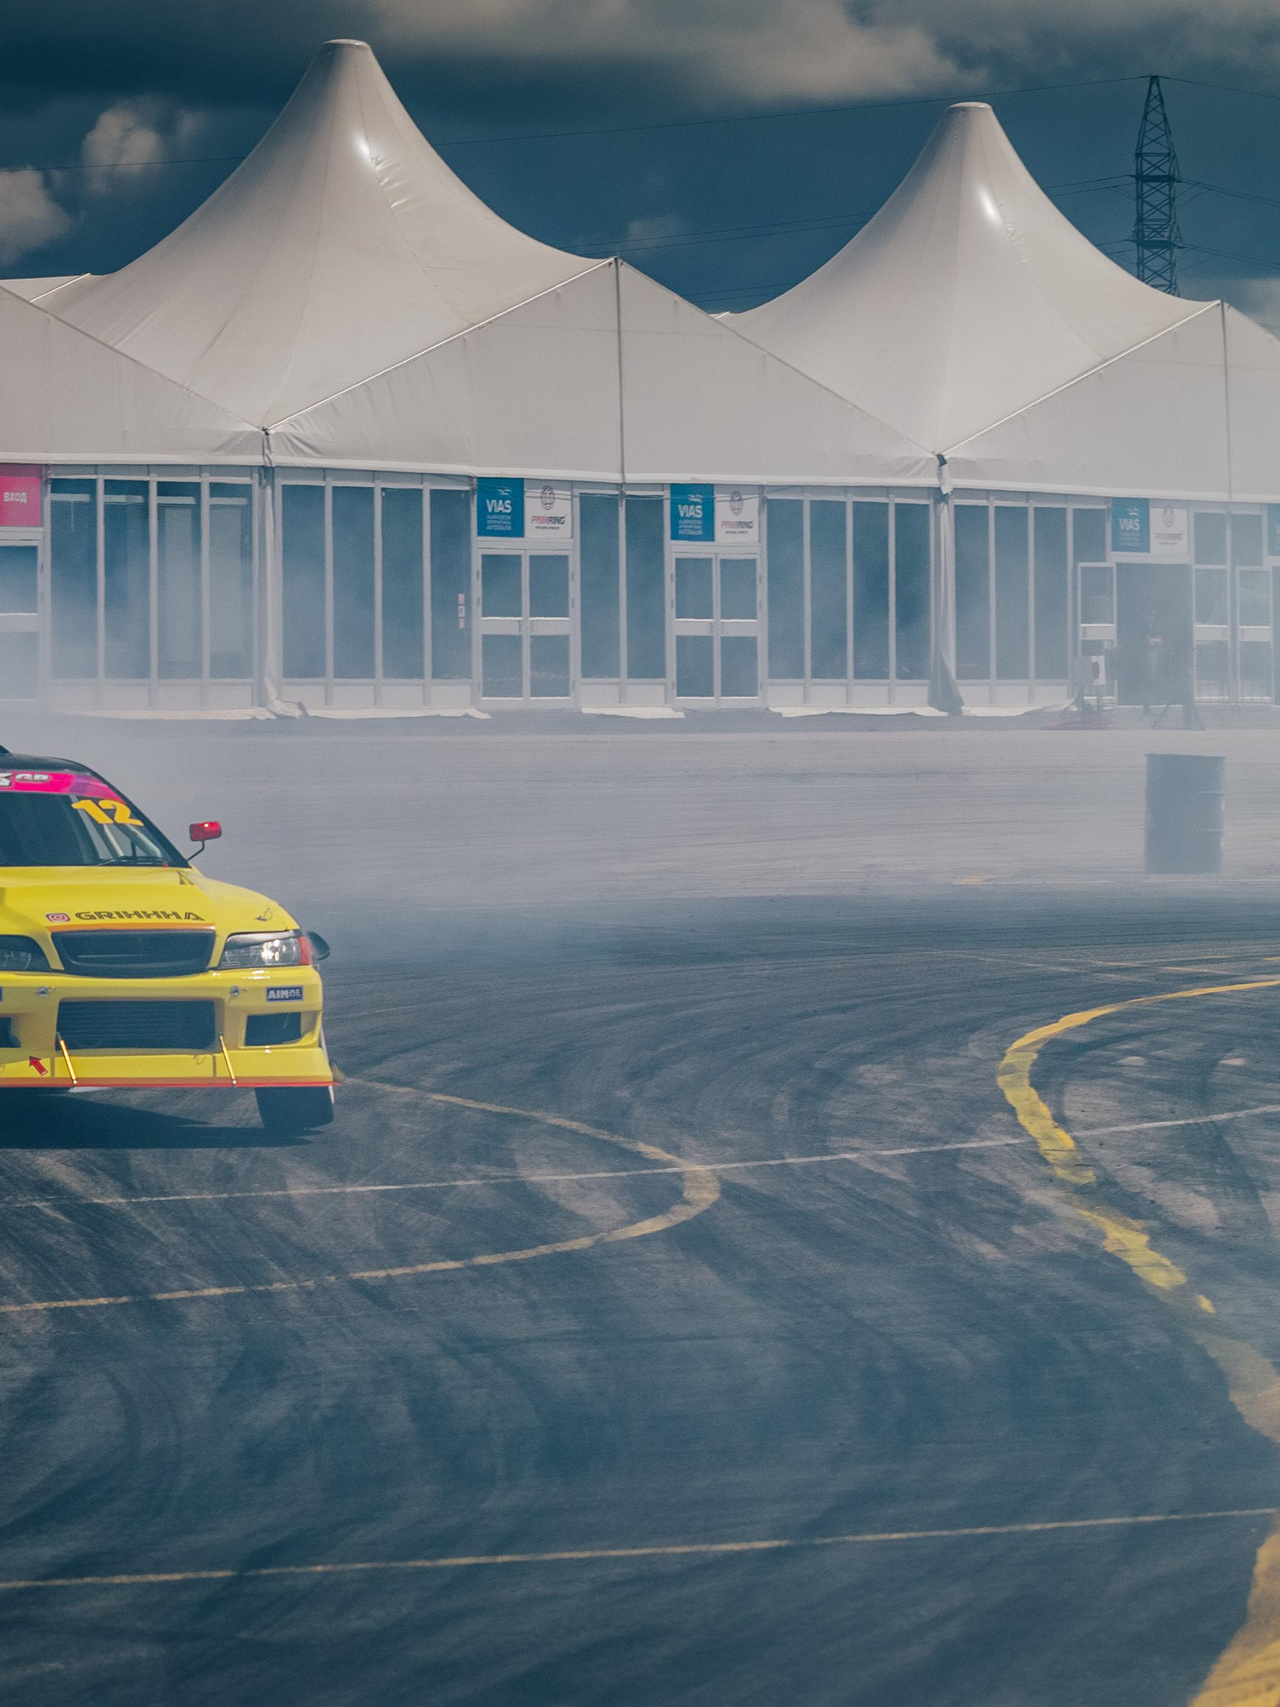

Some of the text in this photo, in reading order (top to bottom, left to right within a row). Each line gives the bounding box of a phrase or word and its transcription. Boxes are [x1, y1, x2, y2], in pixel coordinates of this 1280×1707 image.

[3, 491, 28, 504] ВХОД
[485, 499, 512, 513] VIAS
[677, 504, 703, 518] VIAS
[530, 515, 566, 525] PRIMRING
[71, 799, 144, 826] 12
[268, 988, 302, 999] AIMOL
